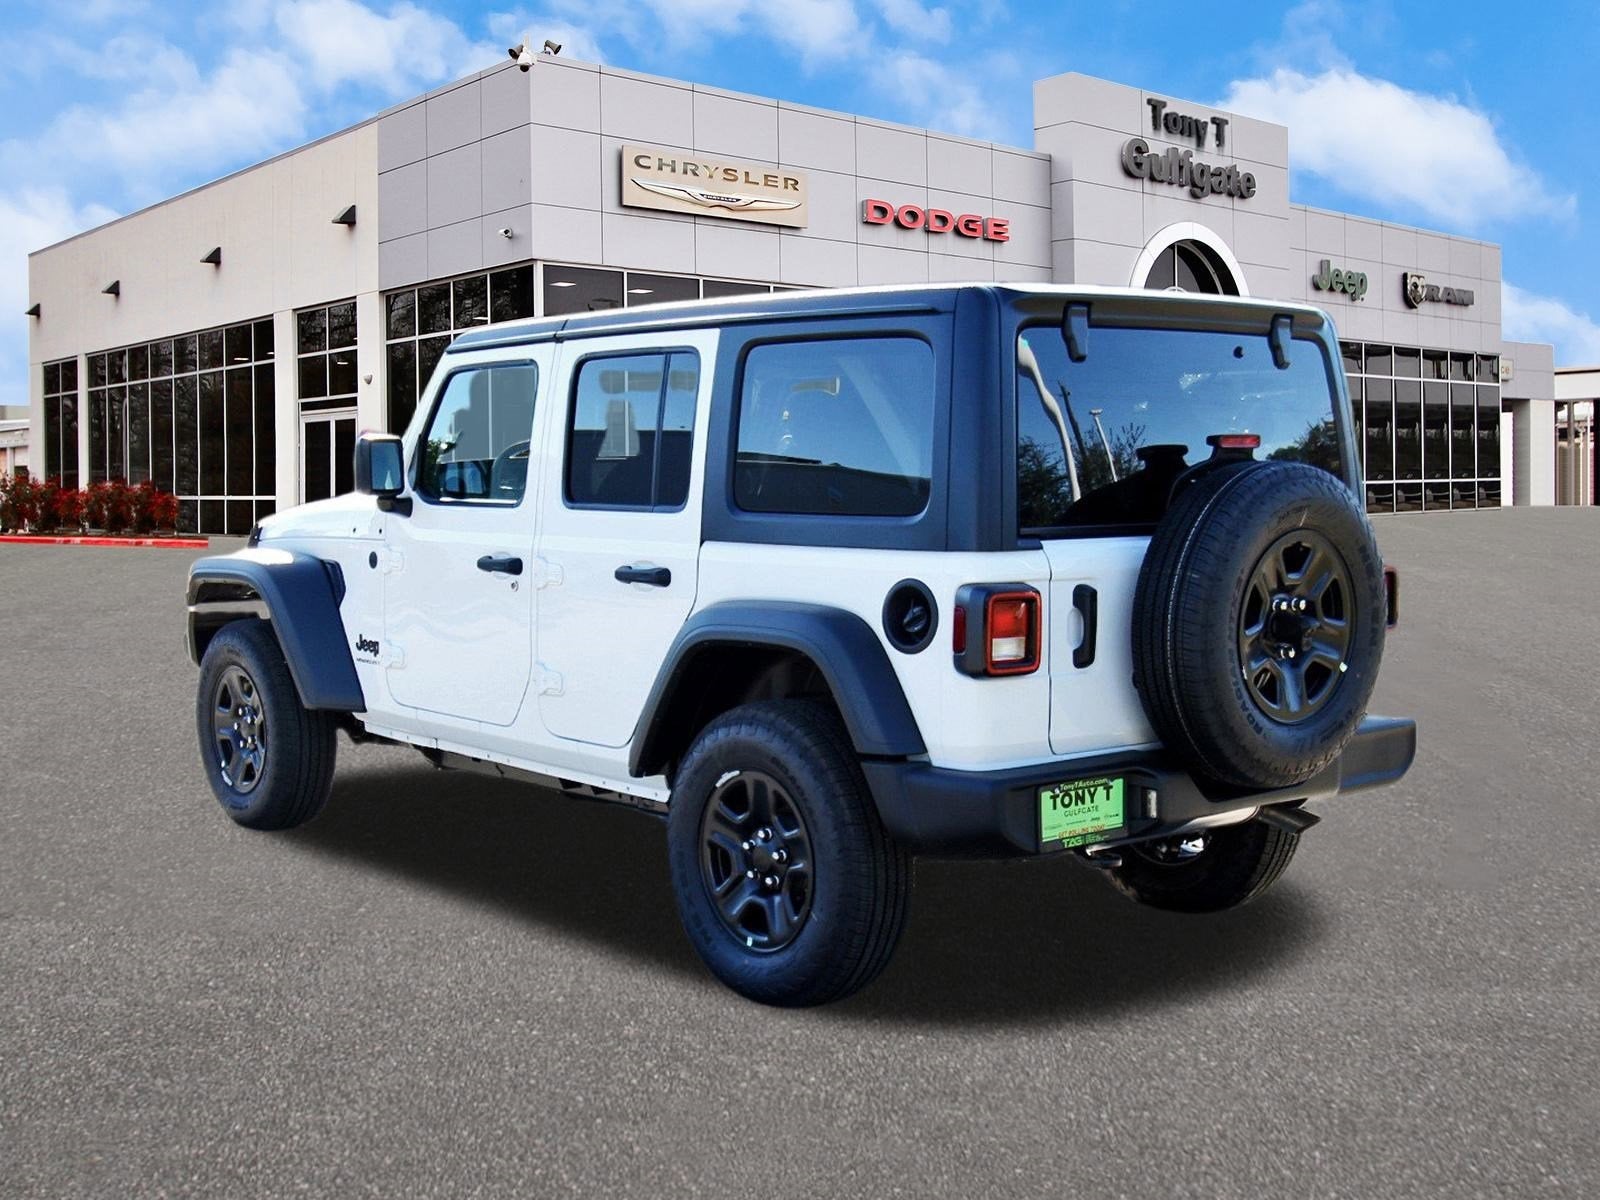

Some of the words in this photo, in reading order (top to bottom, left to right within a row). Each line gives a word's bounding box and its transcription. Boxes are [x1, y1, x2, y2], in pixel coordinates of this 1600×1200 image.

[1147, 98, 1208, 148] Tony
[1210, 116, 1229, 148] T
[633, 154, 800, 192] CHRYSLER
[1121, 138, 1256, 199] Gulfgate
[862, 199, 1010, 242] DODGE
[1312, 259, 1368, 302] Jeep
[1424, 284, 1475, 306] RAM
[356, 634, 379, 657] Jeep
[1050, 787, 1097, 811] TONY
[1103, 785, 1113, 801] T
[1063, 805, 1099, 818] GULFGATE
